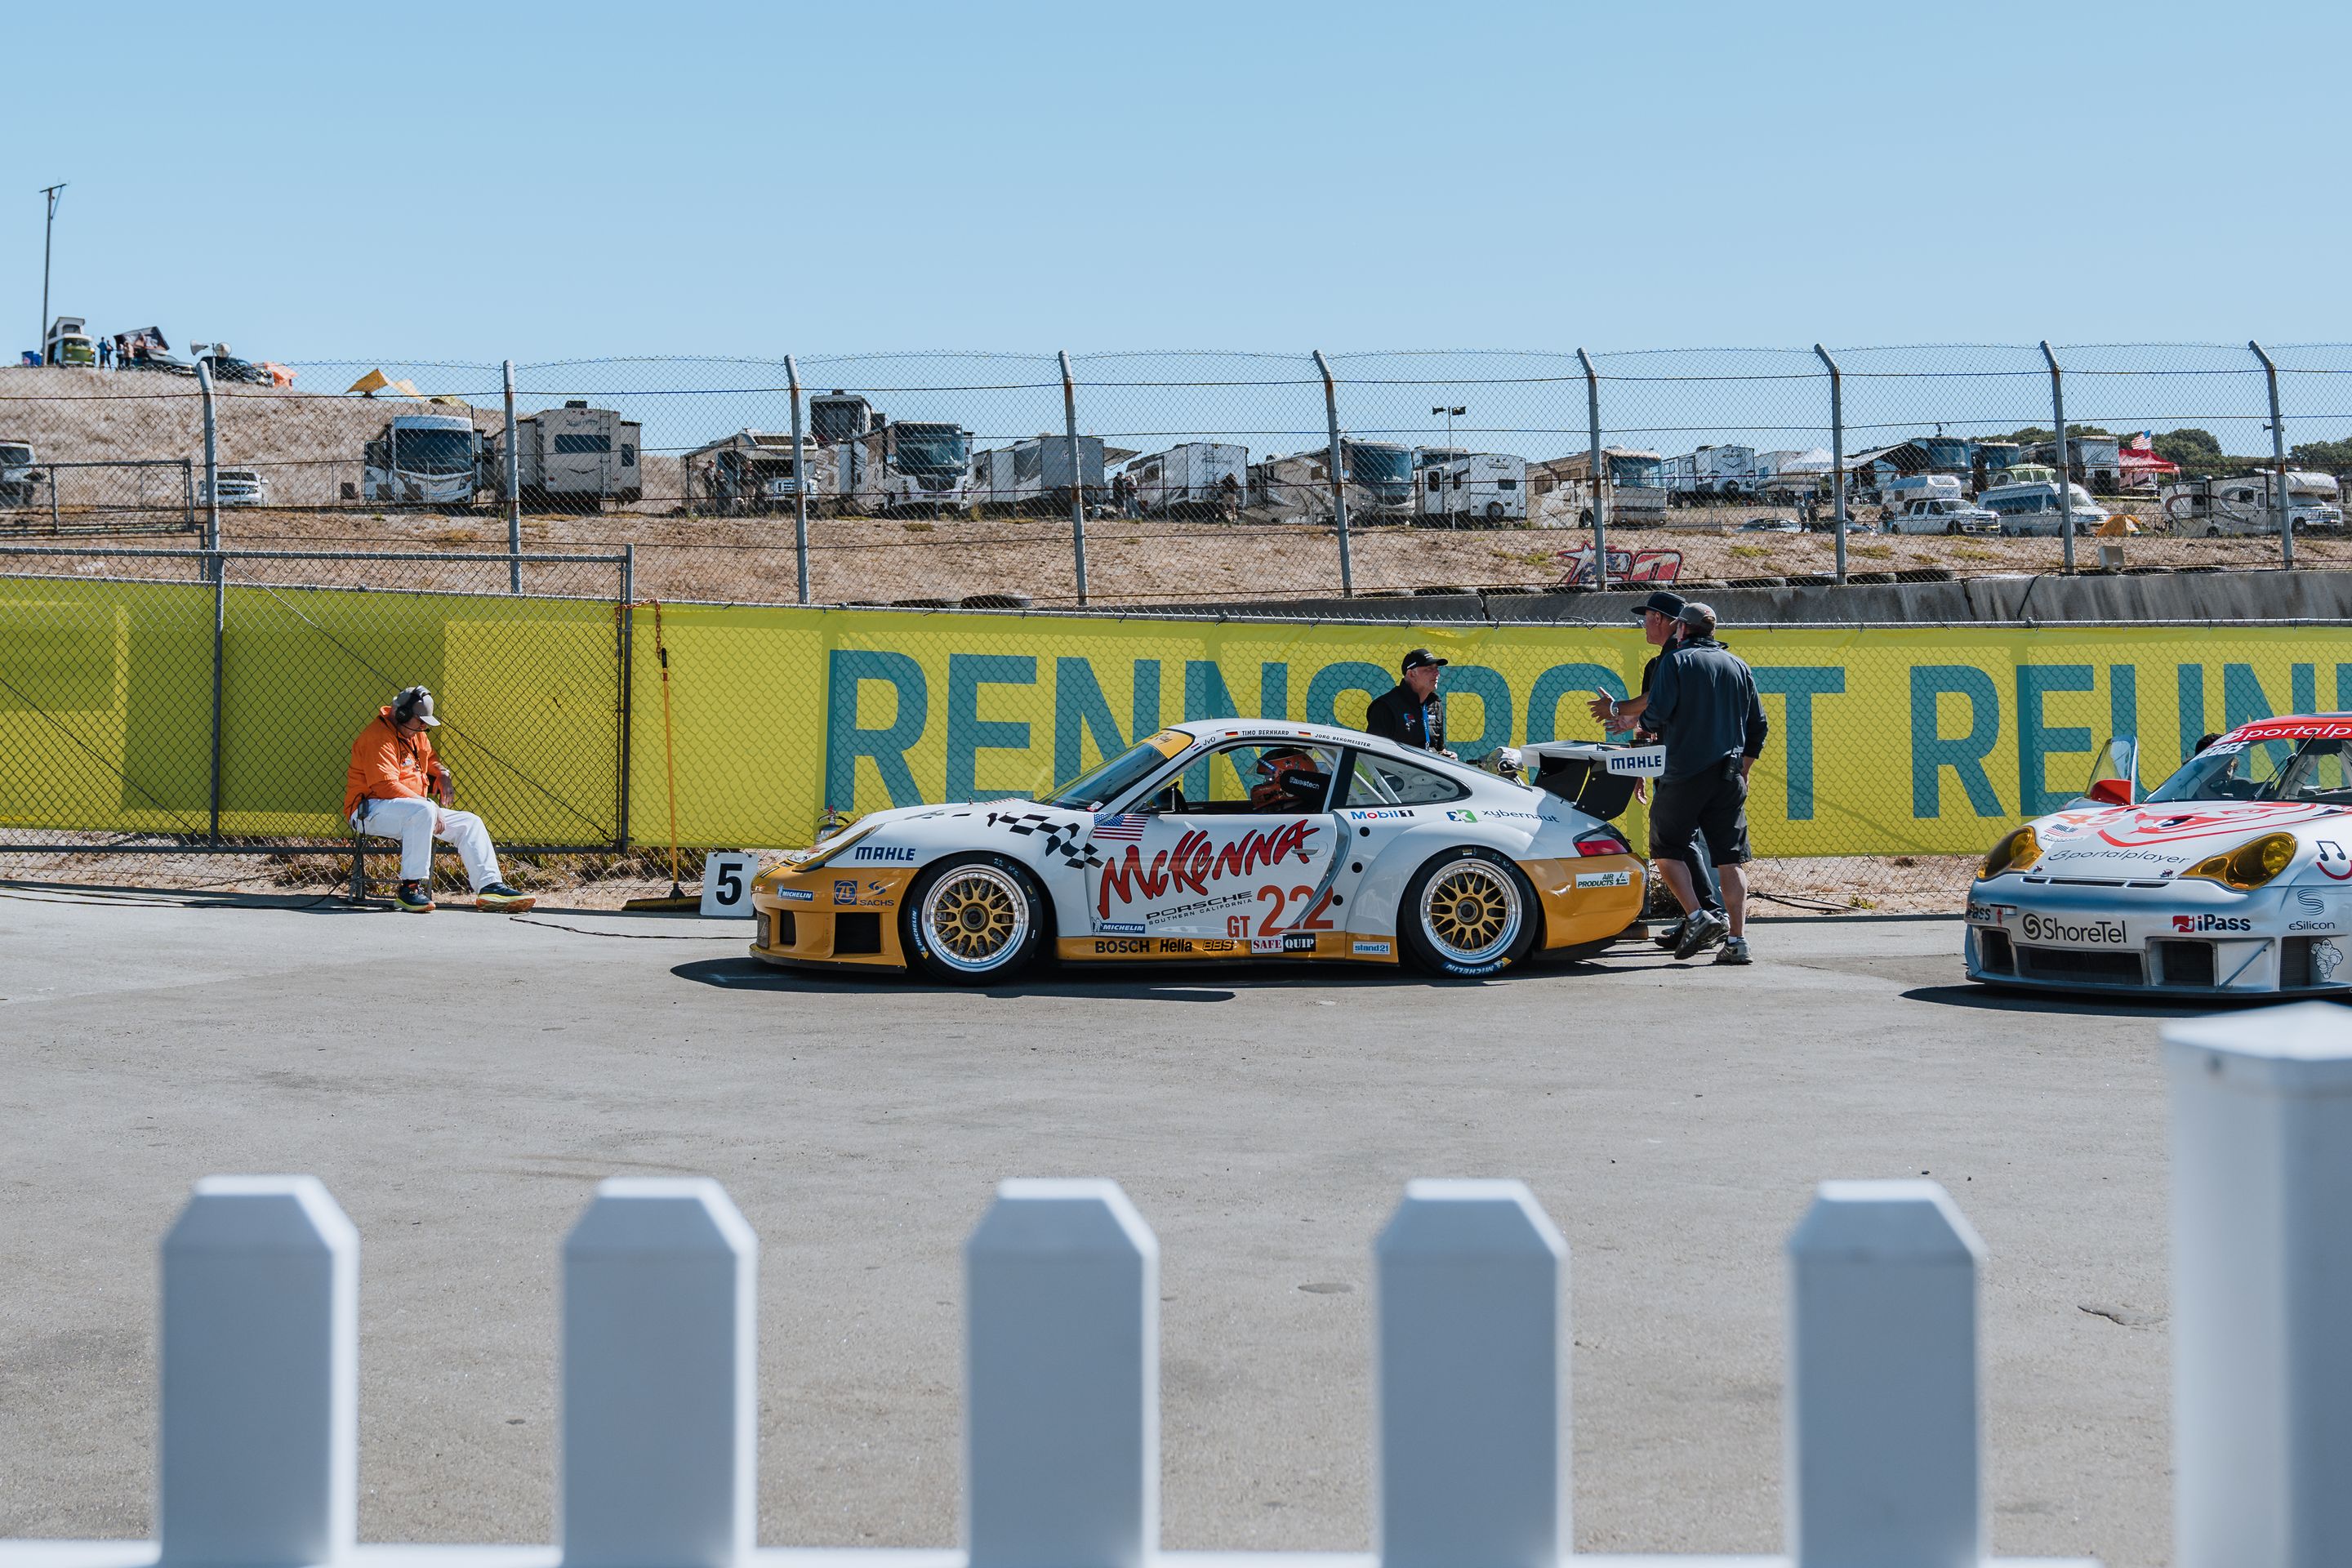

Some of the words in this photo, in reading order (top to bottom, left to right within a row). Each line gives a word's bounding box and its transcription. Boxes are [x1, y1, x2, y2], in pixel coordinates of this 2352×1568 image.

[824, 649, 1845, 820] RENNPOT
[1333, 737, 1371, 747] BERGMEISTER
[1611, 755, 1661, 769] MAHLE
[1481, 809, 1560, 823] xybernaut
[855, 847, 915, 861] MAHLE
[2065, 849, 2190, 865] portalplayer
[716, 863, 742, 906] 5
[834, 885, 854, 900] ZF
[1146, 890, 1253, 920] PORSCHE
[1149, 911, 1195, 925] SOUTHERN
[1200, 898, 1252, 914] CALIFORNIA
[1256, 884, 1334, 937] 22
[911, 910, 923, 947] MICHELIN
[1102, 924, 1144, 932] MICHELIN
[1227, 915, 1250, 938] GT
[2043, 917, 2127, 943] ShoreTel
[2197, 914, 2252, 931] iPass
[2288, 920, 2336, 930] eSilicon
[1095, 941, 1150, 954] BOSCH
[1160, 940, 1192, 952] Hella
[1202, 939, 1234, 951] BBS
[1253, 939, 1282, 949] SAFE
[1285, 938, 1315, 949] QUIP
[1354, 944, 1389, 952] stand21
[1446, 964, 1494, 974] MICHELIN
